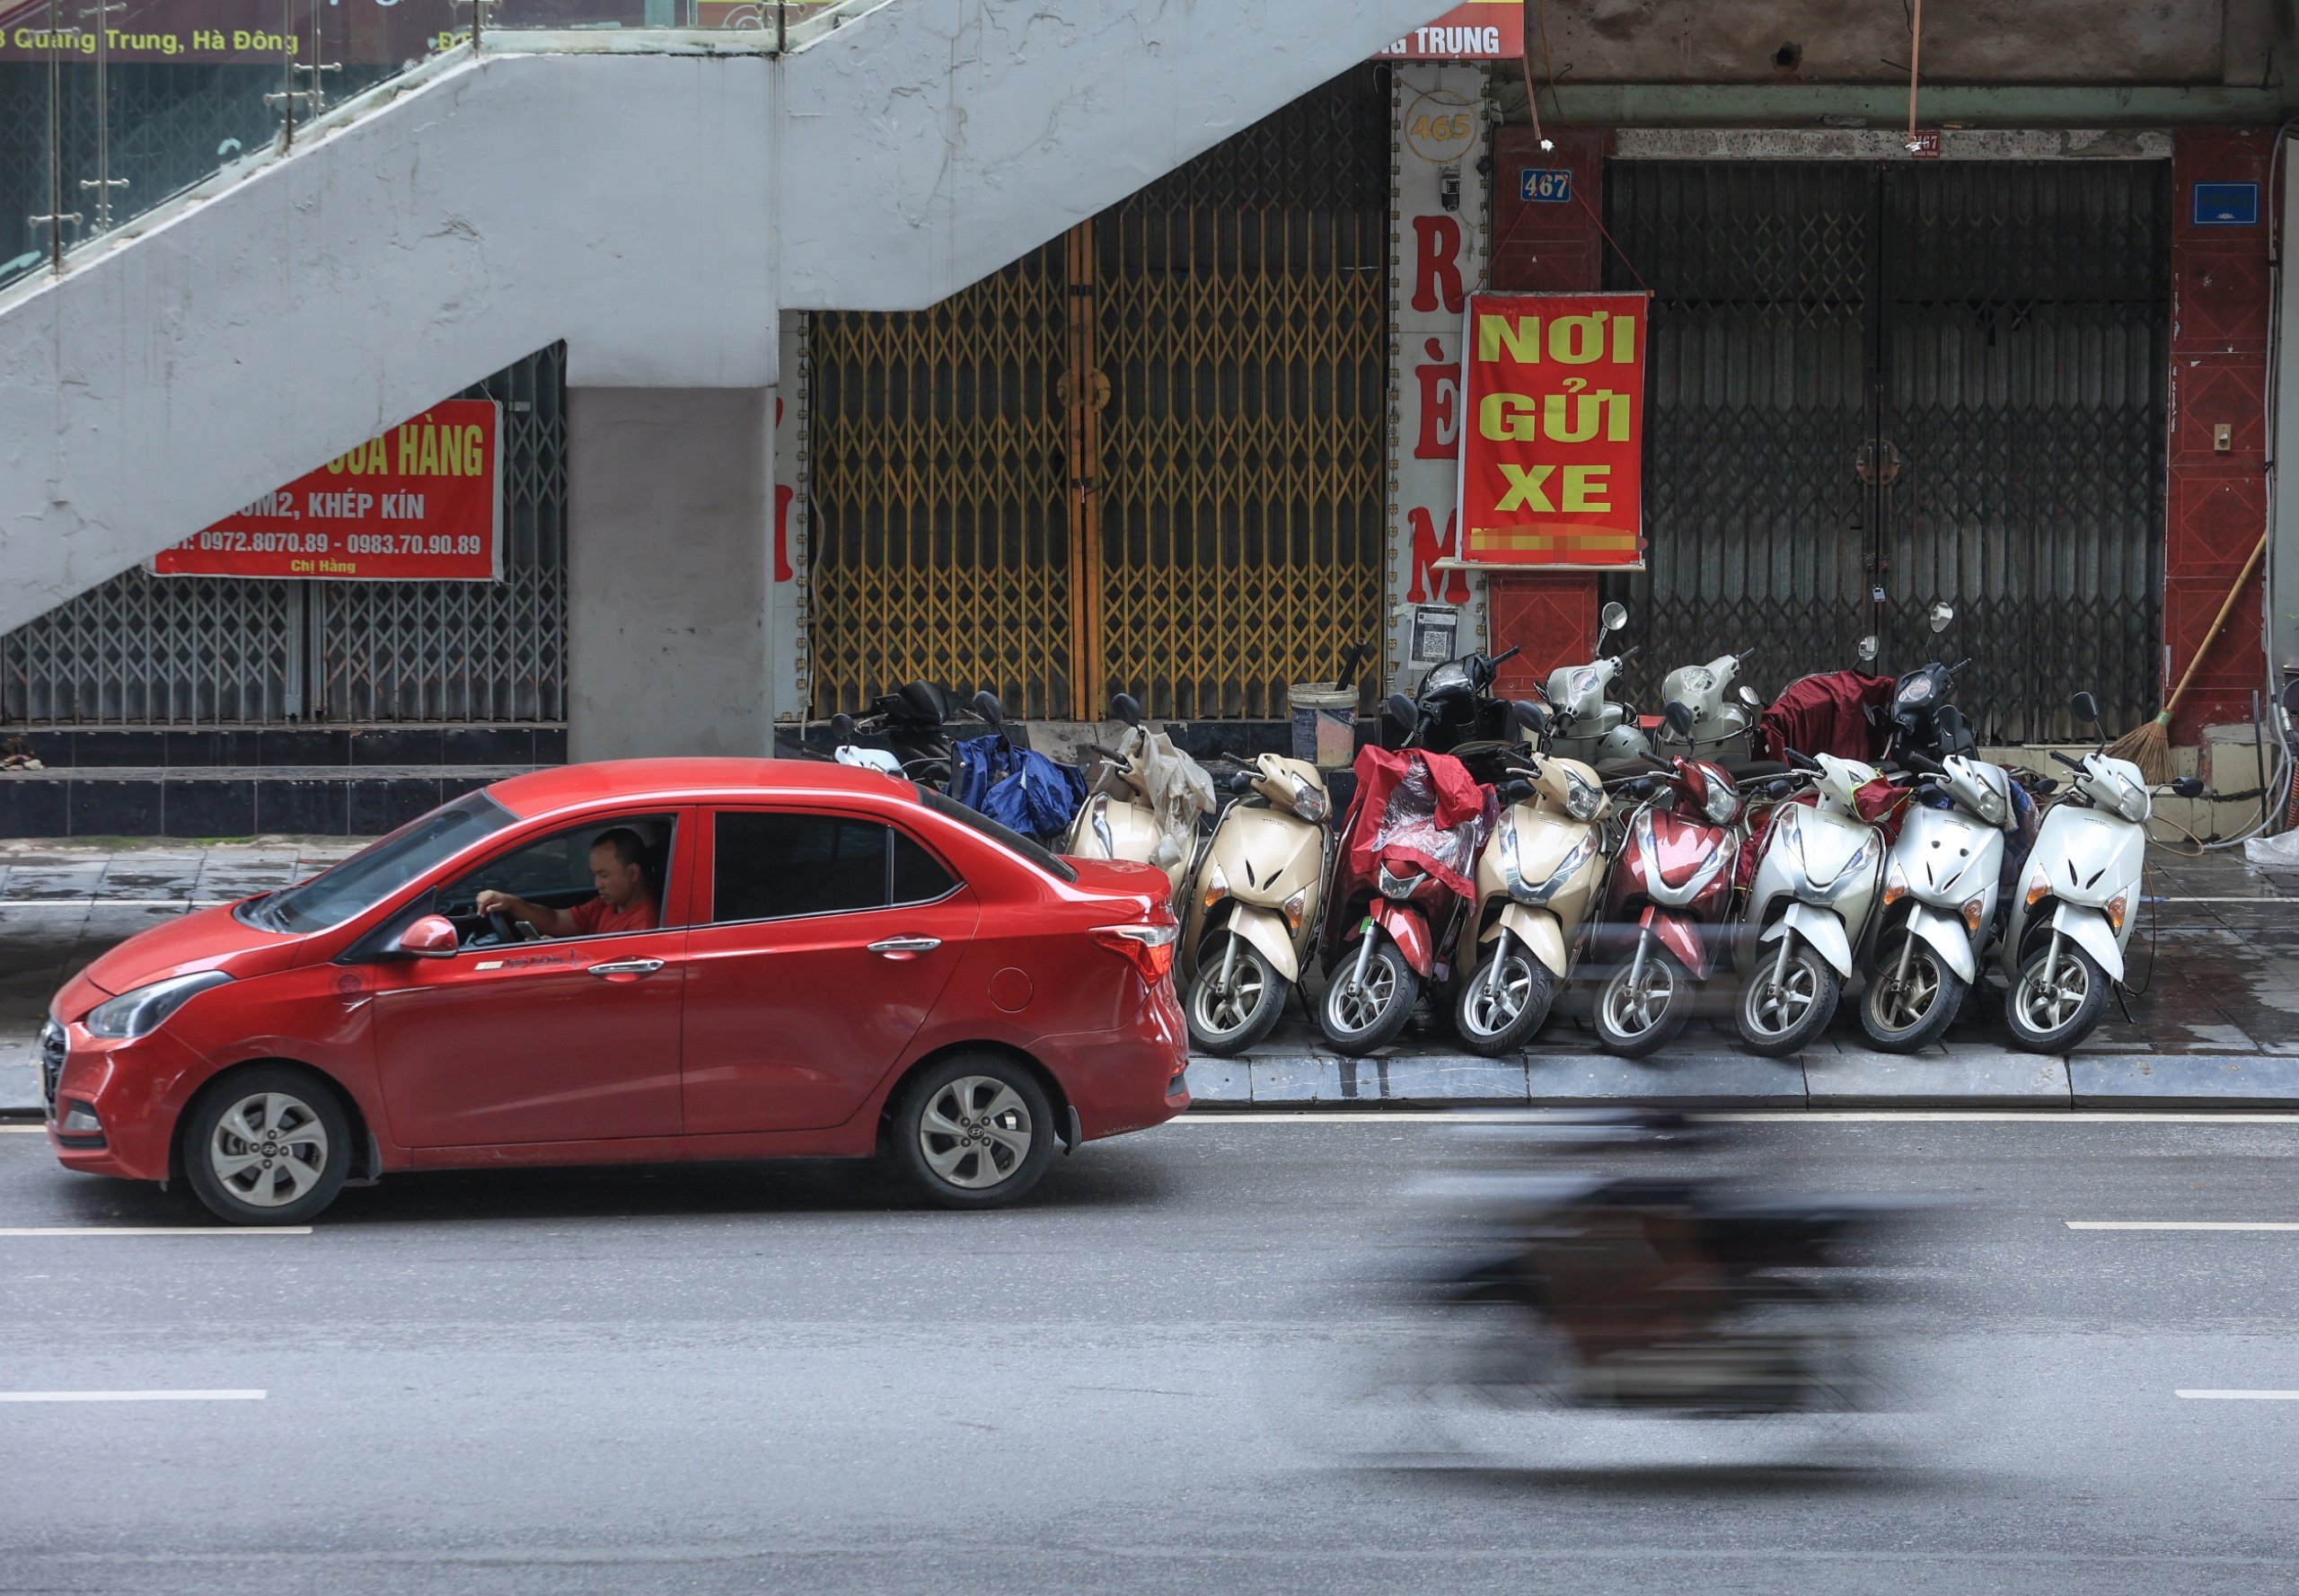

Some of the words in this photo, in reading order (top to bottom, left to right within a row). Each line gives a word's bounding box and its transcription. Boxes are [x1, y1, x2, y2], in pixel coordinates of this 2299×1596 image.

[13, 28, 95, 54] Quang
[105, 29, 185, 54] Trung,
[193, 29, 225, 50] Hà
[233, 29, 299, 55] Đông
[1414, 26, 1500, 54] TRUNG
[1411, 114, 1470, 141] 465
[1524, 173, 1569, 198] 467
[1477, 311, 1635, 365] NƠI
[1478, 377, 1632, 444] GỬI
[398, 413, 483, 477] HÀNG
[1493, 463, 1612, 513] XE
[308, 488, 374, 519] KHÉP
[381, 489, 425, 520] KÍN
[199, 531, 329, 553] 0972.8070.89
[347, 533, 481, 555] 0983.70.90.89
[290, 559, 315, 575] Chị
[319, 557, 357, 575] Hằng
